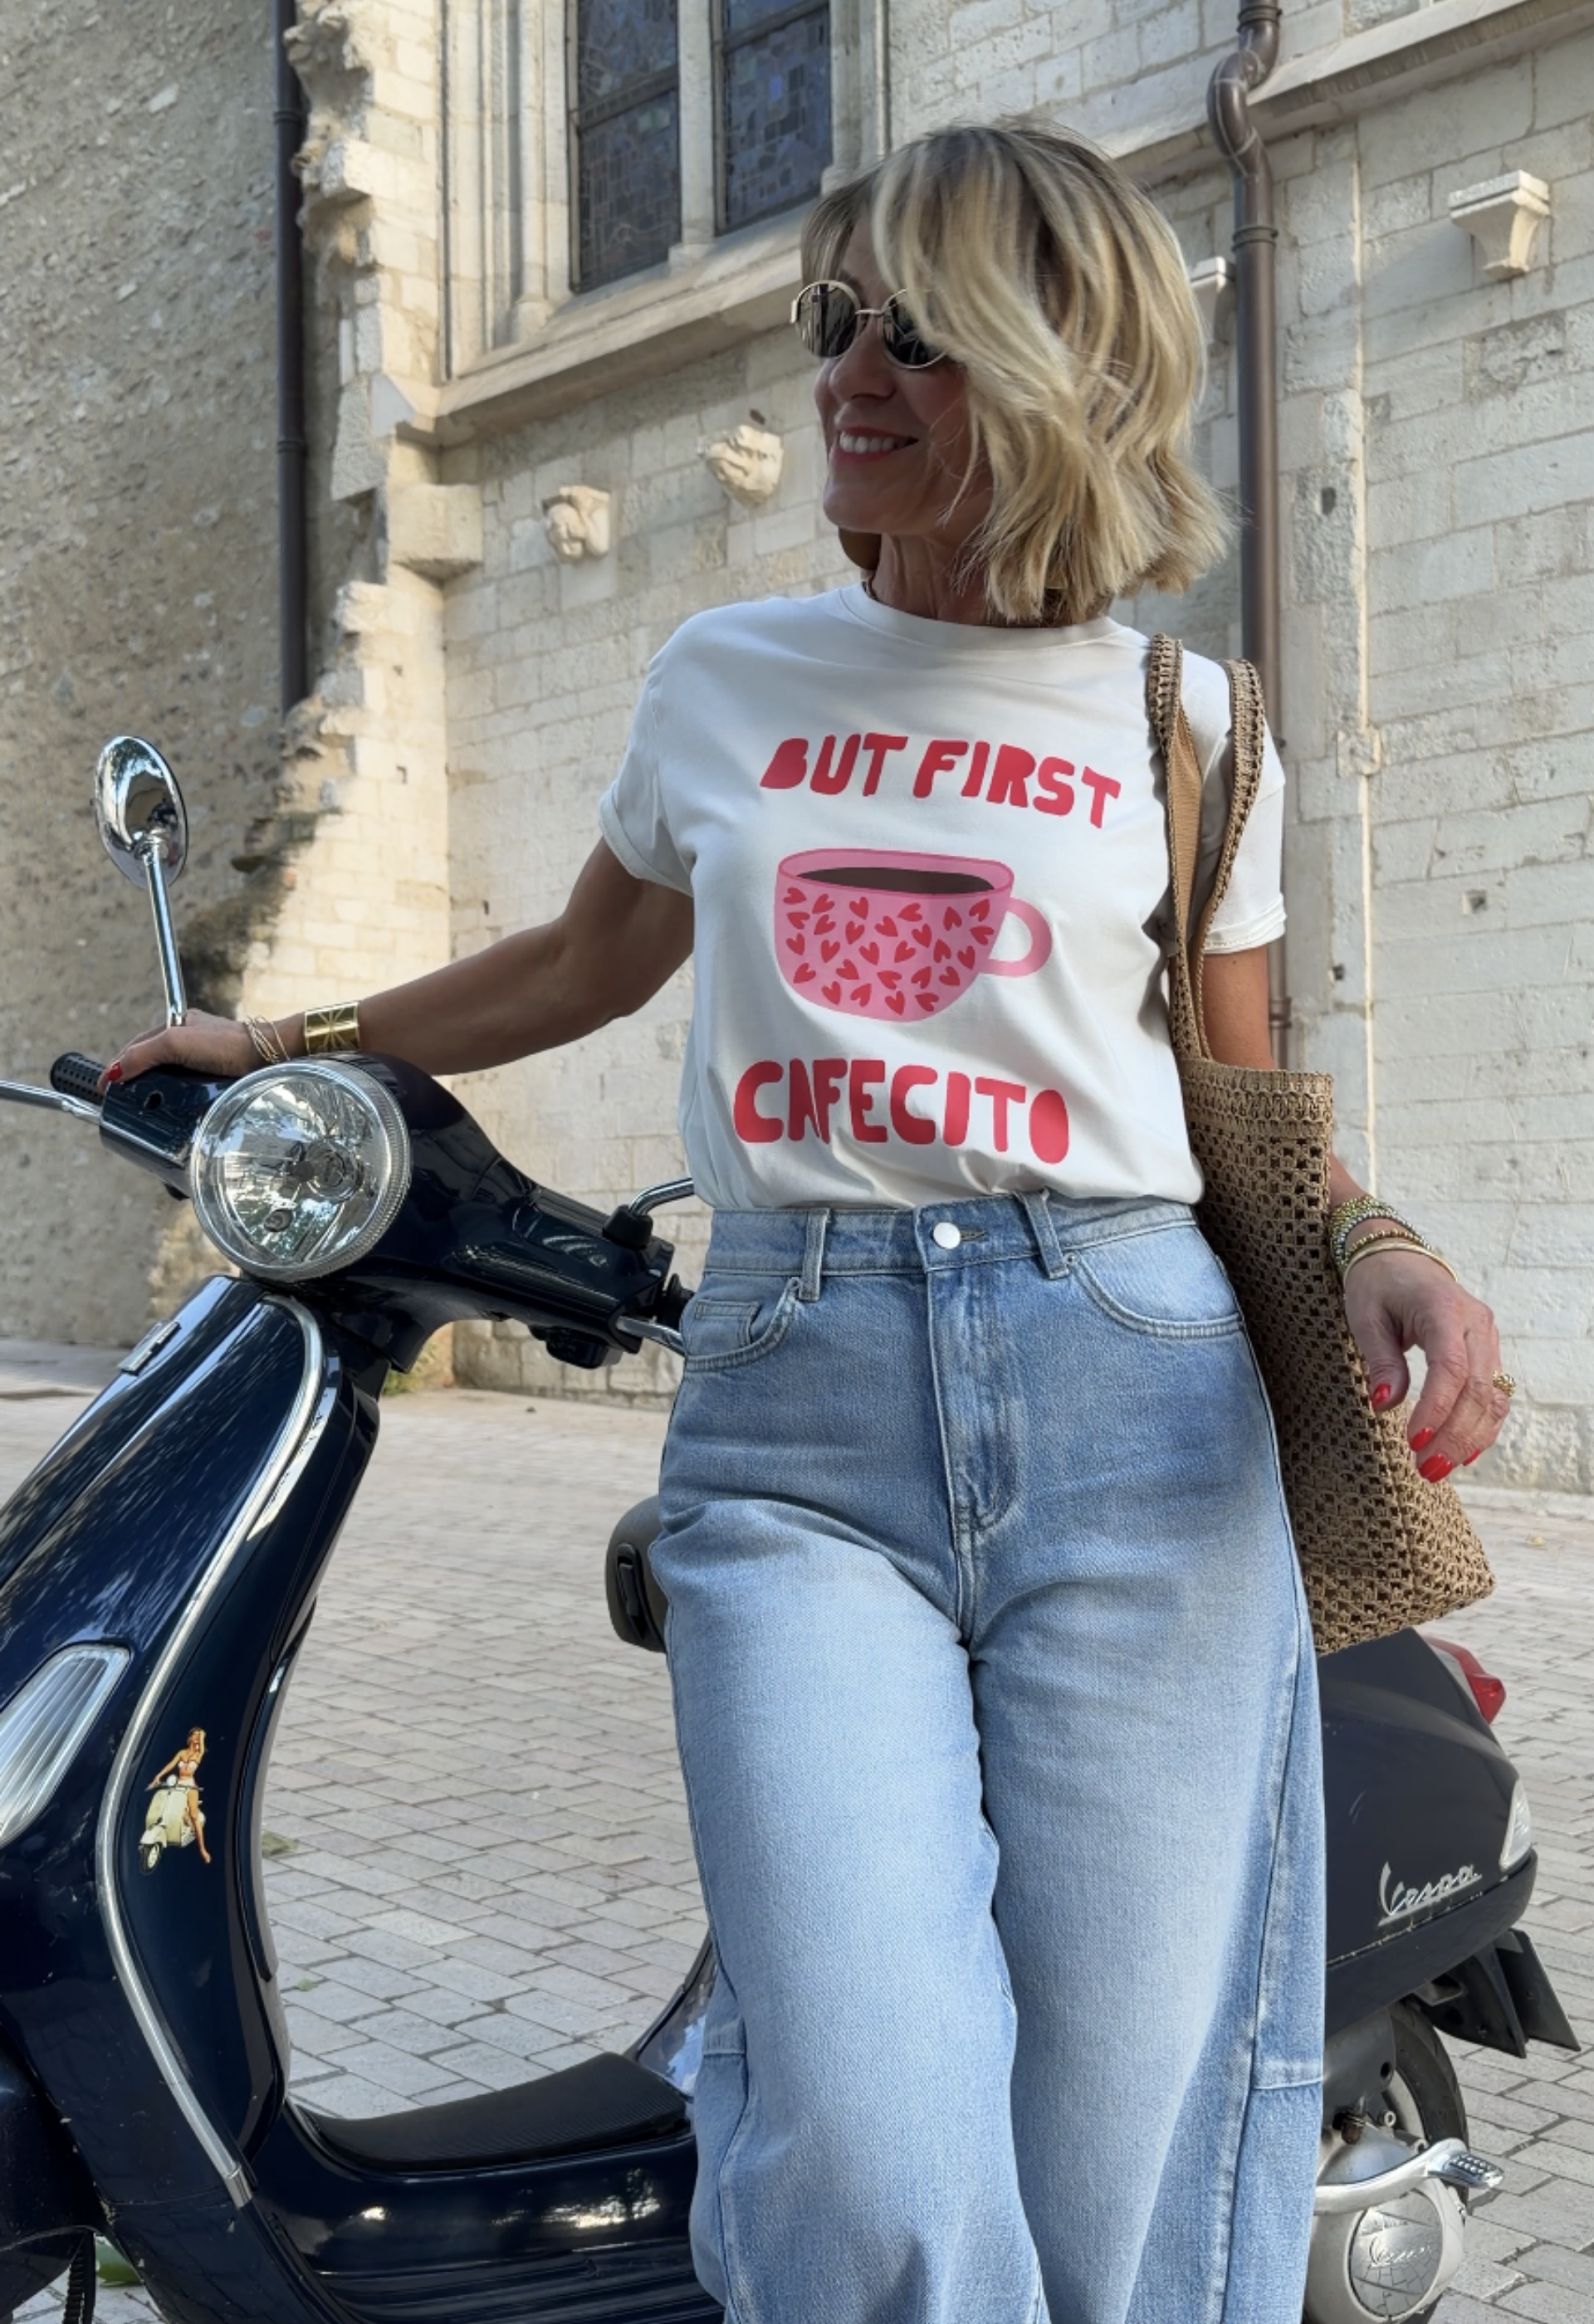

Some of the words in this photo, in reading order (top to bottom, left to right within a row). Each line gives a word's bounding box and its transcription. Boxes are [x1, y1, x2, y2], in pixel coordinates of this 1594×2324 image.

[760, 732, 908, 796] BUT
[912, 740, 1122, 828] FIRST
[733, 1058, 1069, 1164] CAFECITO
[1376, 1862, 1482, 1926] Vespa
